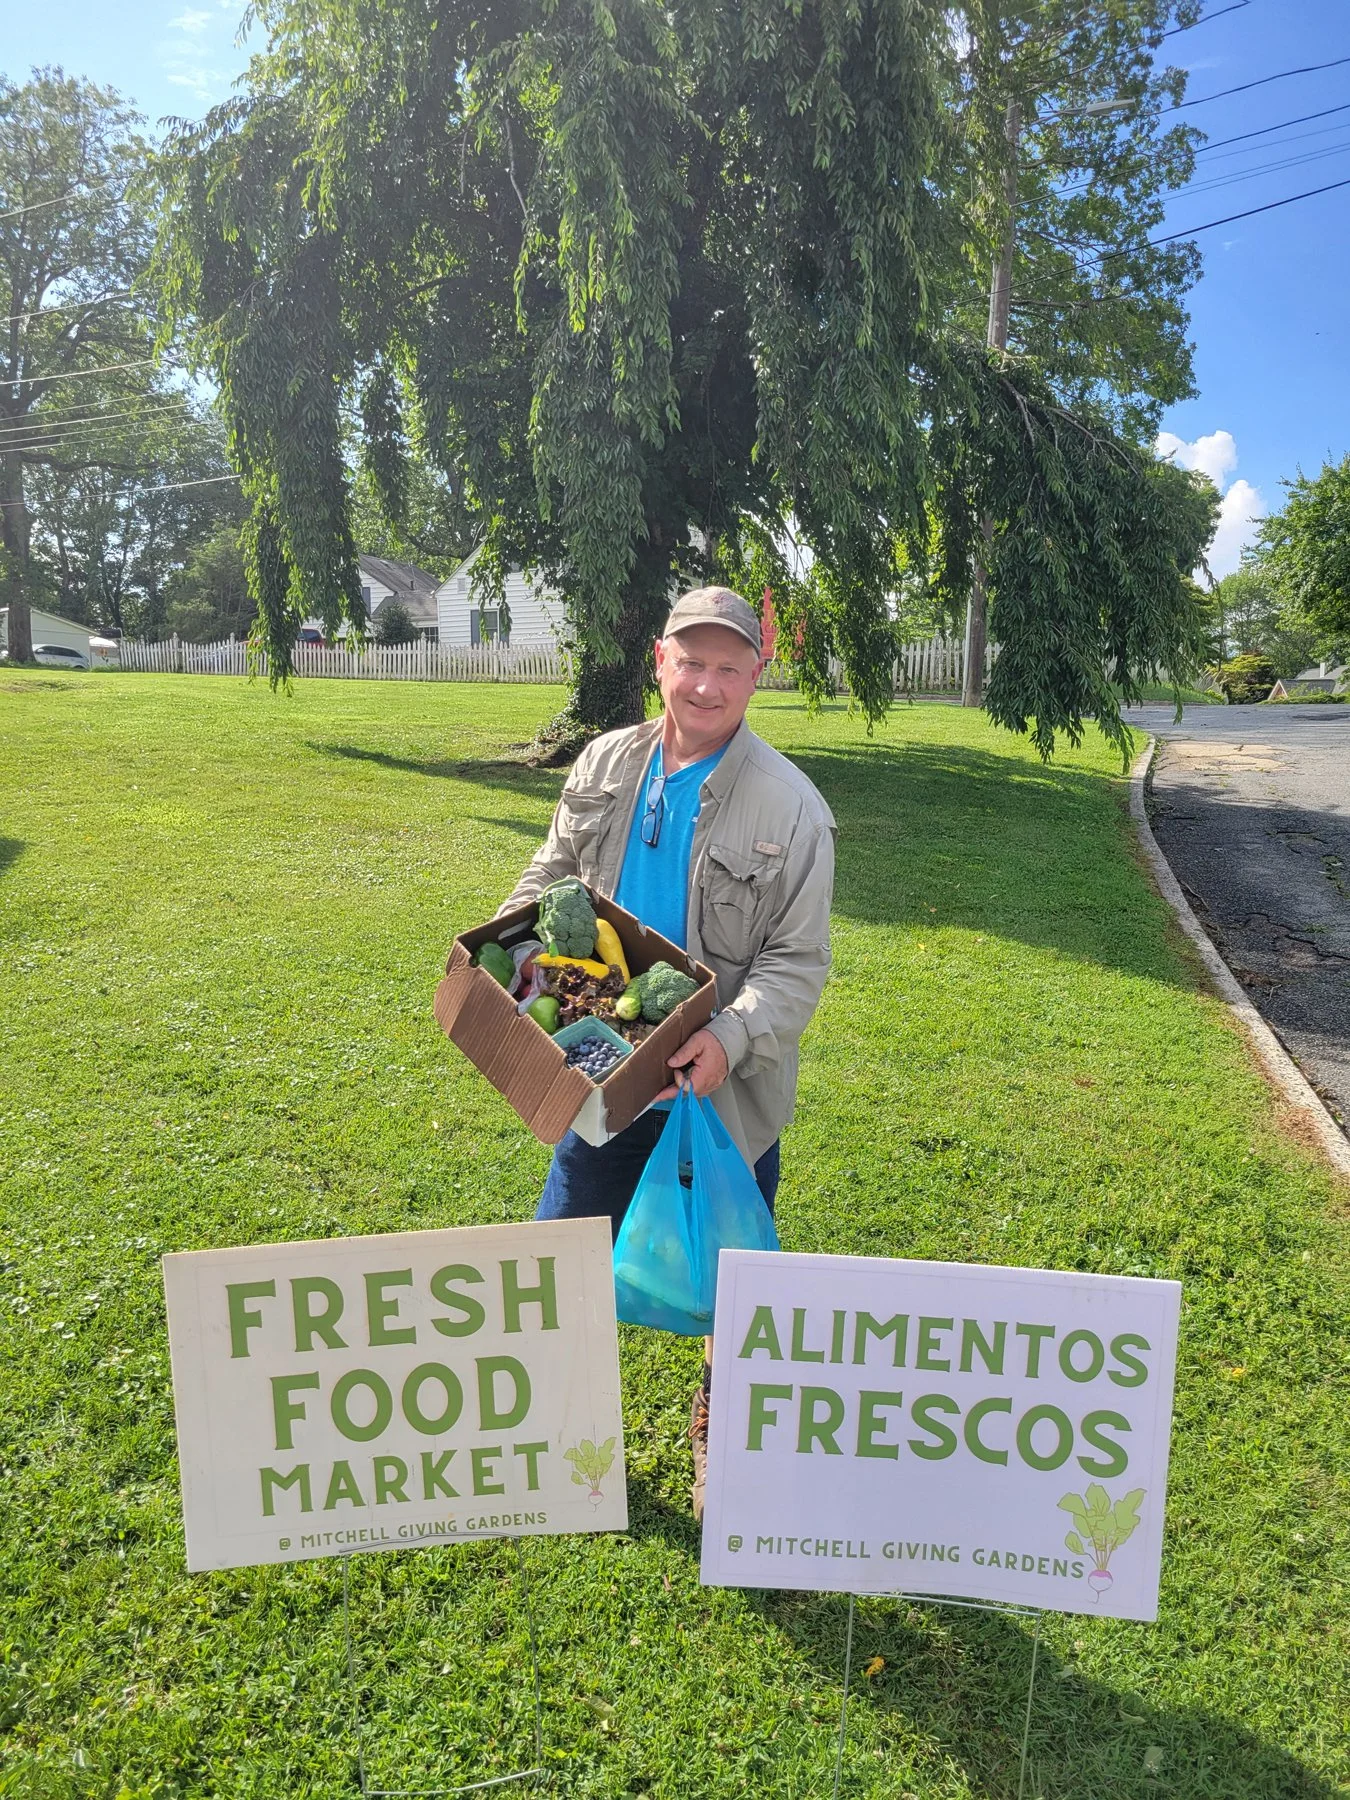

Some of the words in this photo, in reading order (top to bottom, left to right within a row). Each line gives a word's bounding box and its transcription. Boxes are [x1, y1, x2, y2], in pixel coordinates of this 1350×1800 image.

[225, 1256, 560, 1358] FRESH
[738, 1305, 1152, 1388] ALIMENTOS
[270, 1355, 532, 1450] FOOD
[745, 1383, 1133, 1479] FRESCOS
[259, 1440, 549, 1517] MARKET
[279, 1537, 291, 1551] @
[301, 1527, 390, 1549] MITCHELL
[398, 1519, 458, 1538] GIVING
[466, 1511, 547, 1531] GARDENS
[727, 1534, 743, 1553] @
[756, 1535, 871, 1559] MITCHELL
[882, 1541, 960, 1563] GIVING
[972, 1548, 1085, 1579] GARDENS
